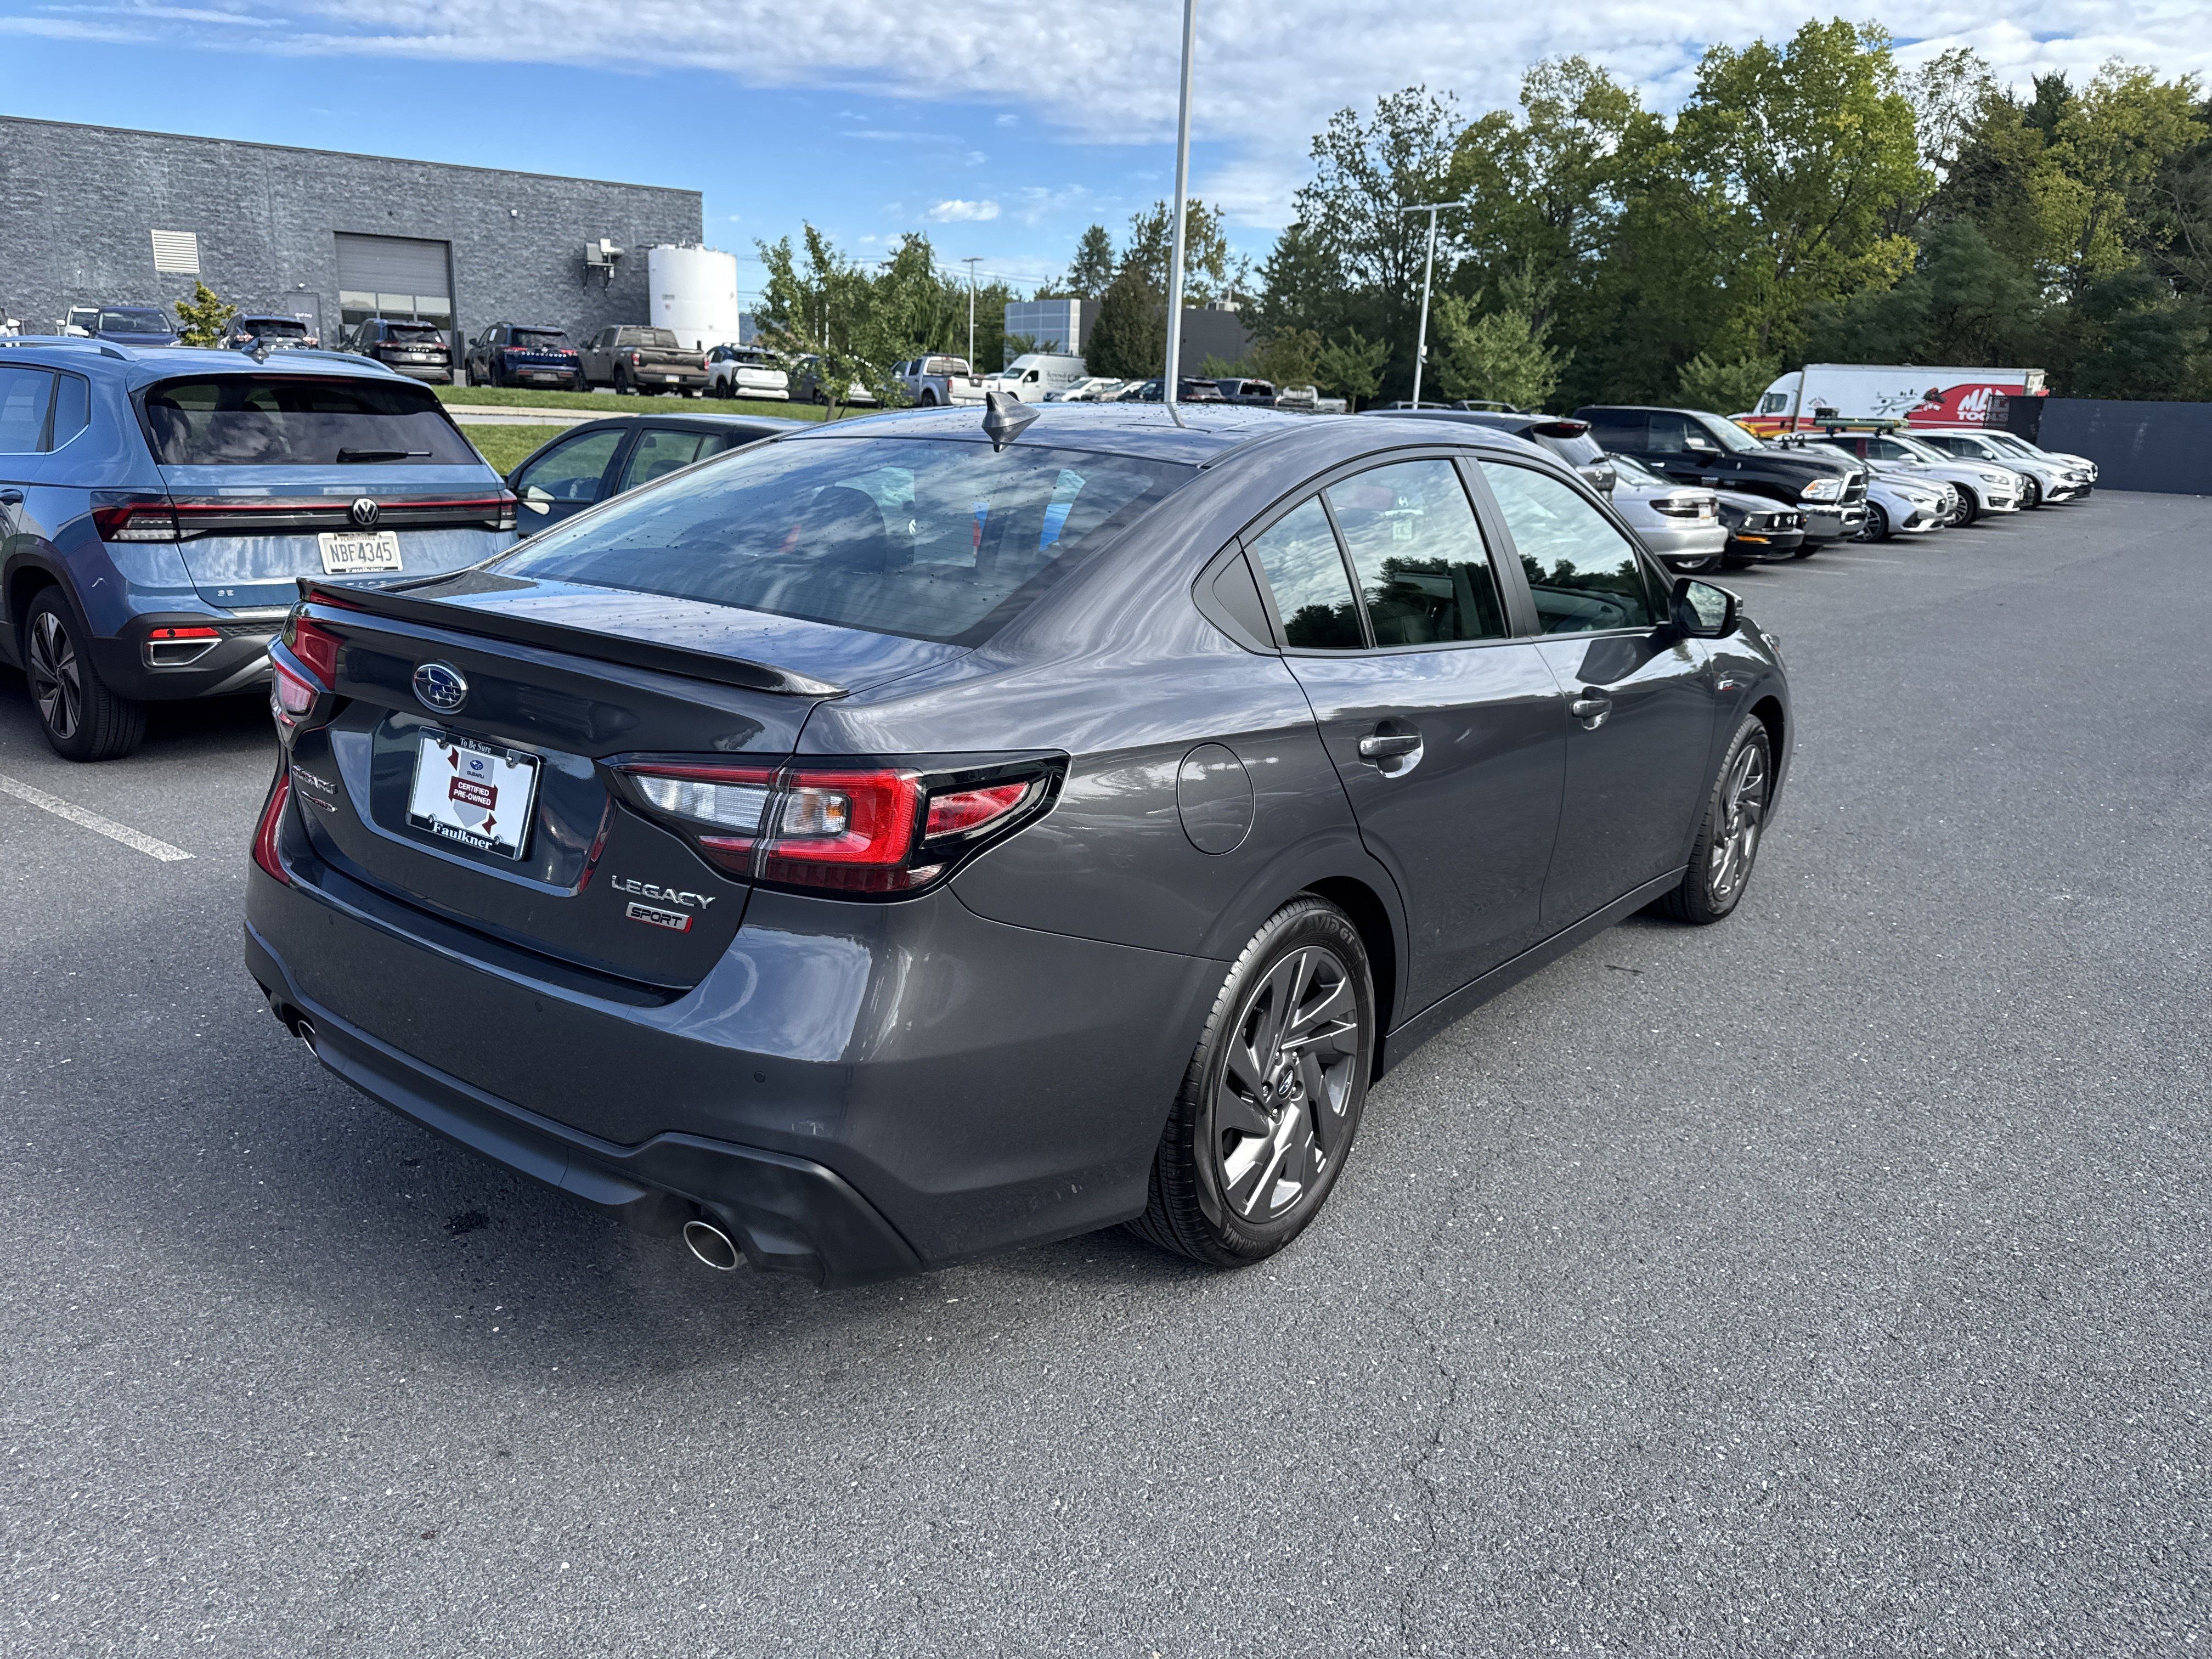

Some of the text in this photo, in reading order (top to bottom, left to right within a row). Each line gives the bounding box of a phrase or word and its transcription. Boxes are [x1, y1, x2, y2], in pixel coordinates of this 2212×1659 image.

[460, 737, 492, 754] To Be Sure
[466, 770, 484, 779] SUBARU
[454, 788, 491, 805] PRE-OWNED
[458, 781, 489, 797] CERTIFIED
[432, 821, 493, 850] Faulkner
[612, 875, 716, 909] LEGACY
[630, 906, 682, 926] SPORT
